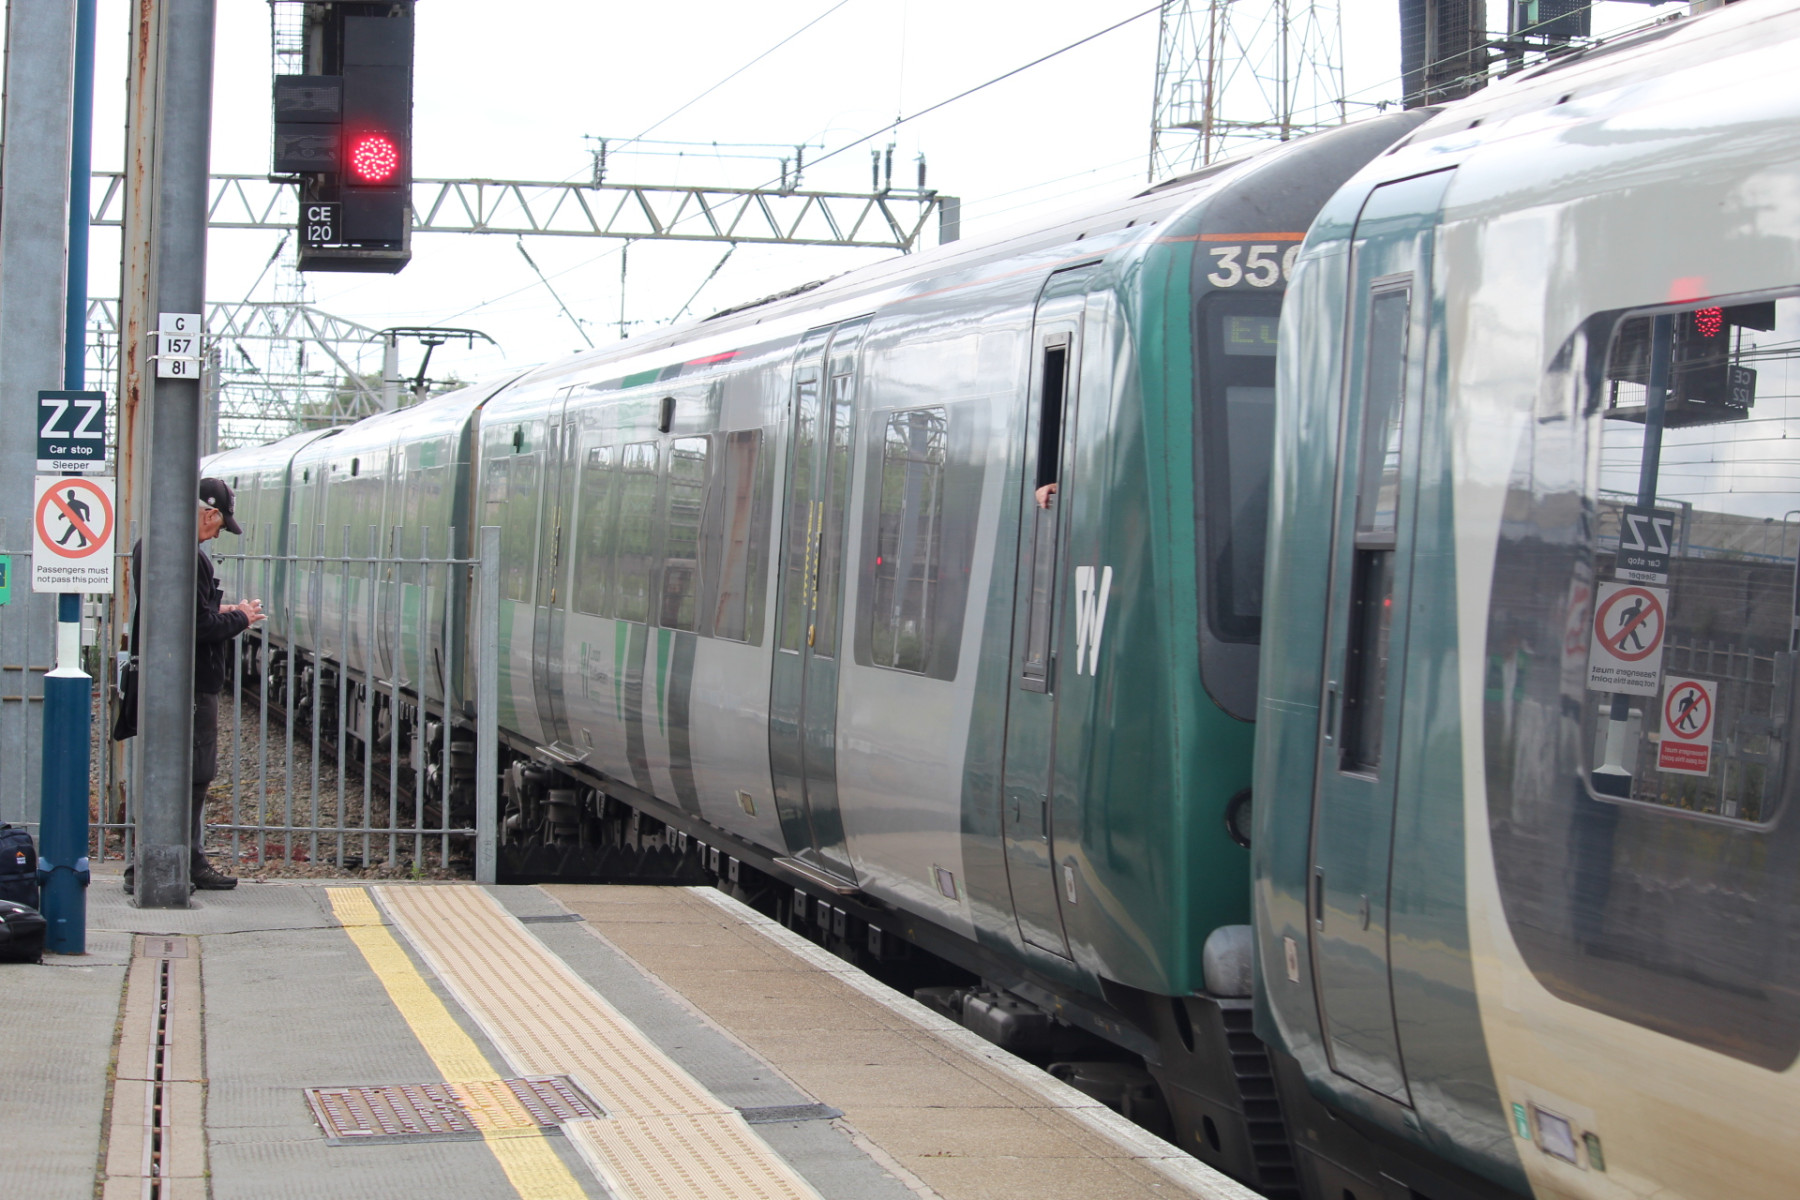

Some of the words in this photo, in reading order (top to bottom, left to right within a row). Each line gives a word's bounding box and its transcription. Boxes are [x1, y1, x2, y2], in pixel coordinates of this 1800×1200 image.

[308, 206, 331, 221] CE
[308, 225, 331, 241] 120
[175, 317, 185, 331] G
[168, 338, 191, 353] 157
[172, 360, 186, 375] 81
[40, 399, 102, 439] ZZ
[49, 444, 67, 455] Car
[70, 445, 93, 456] stop
[52, 460, 90, 471] Sleeper
[36, 565, 86, 575] Passengers
[87, 566, 109, 575] must
[36, 575, 50, 583] not
[51, 576, 71, 584] pass
[72, 575, 87, 583] this
[87, 576, 109, 585] point
